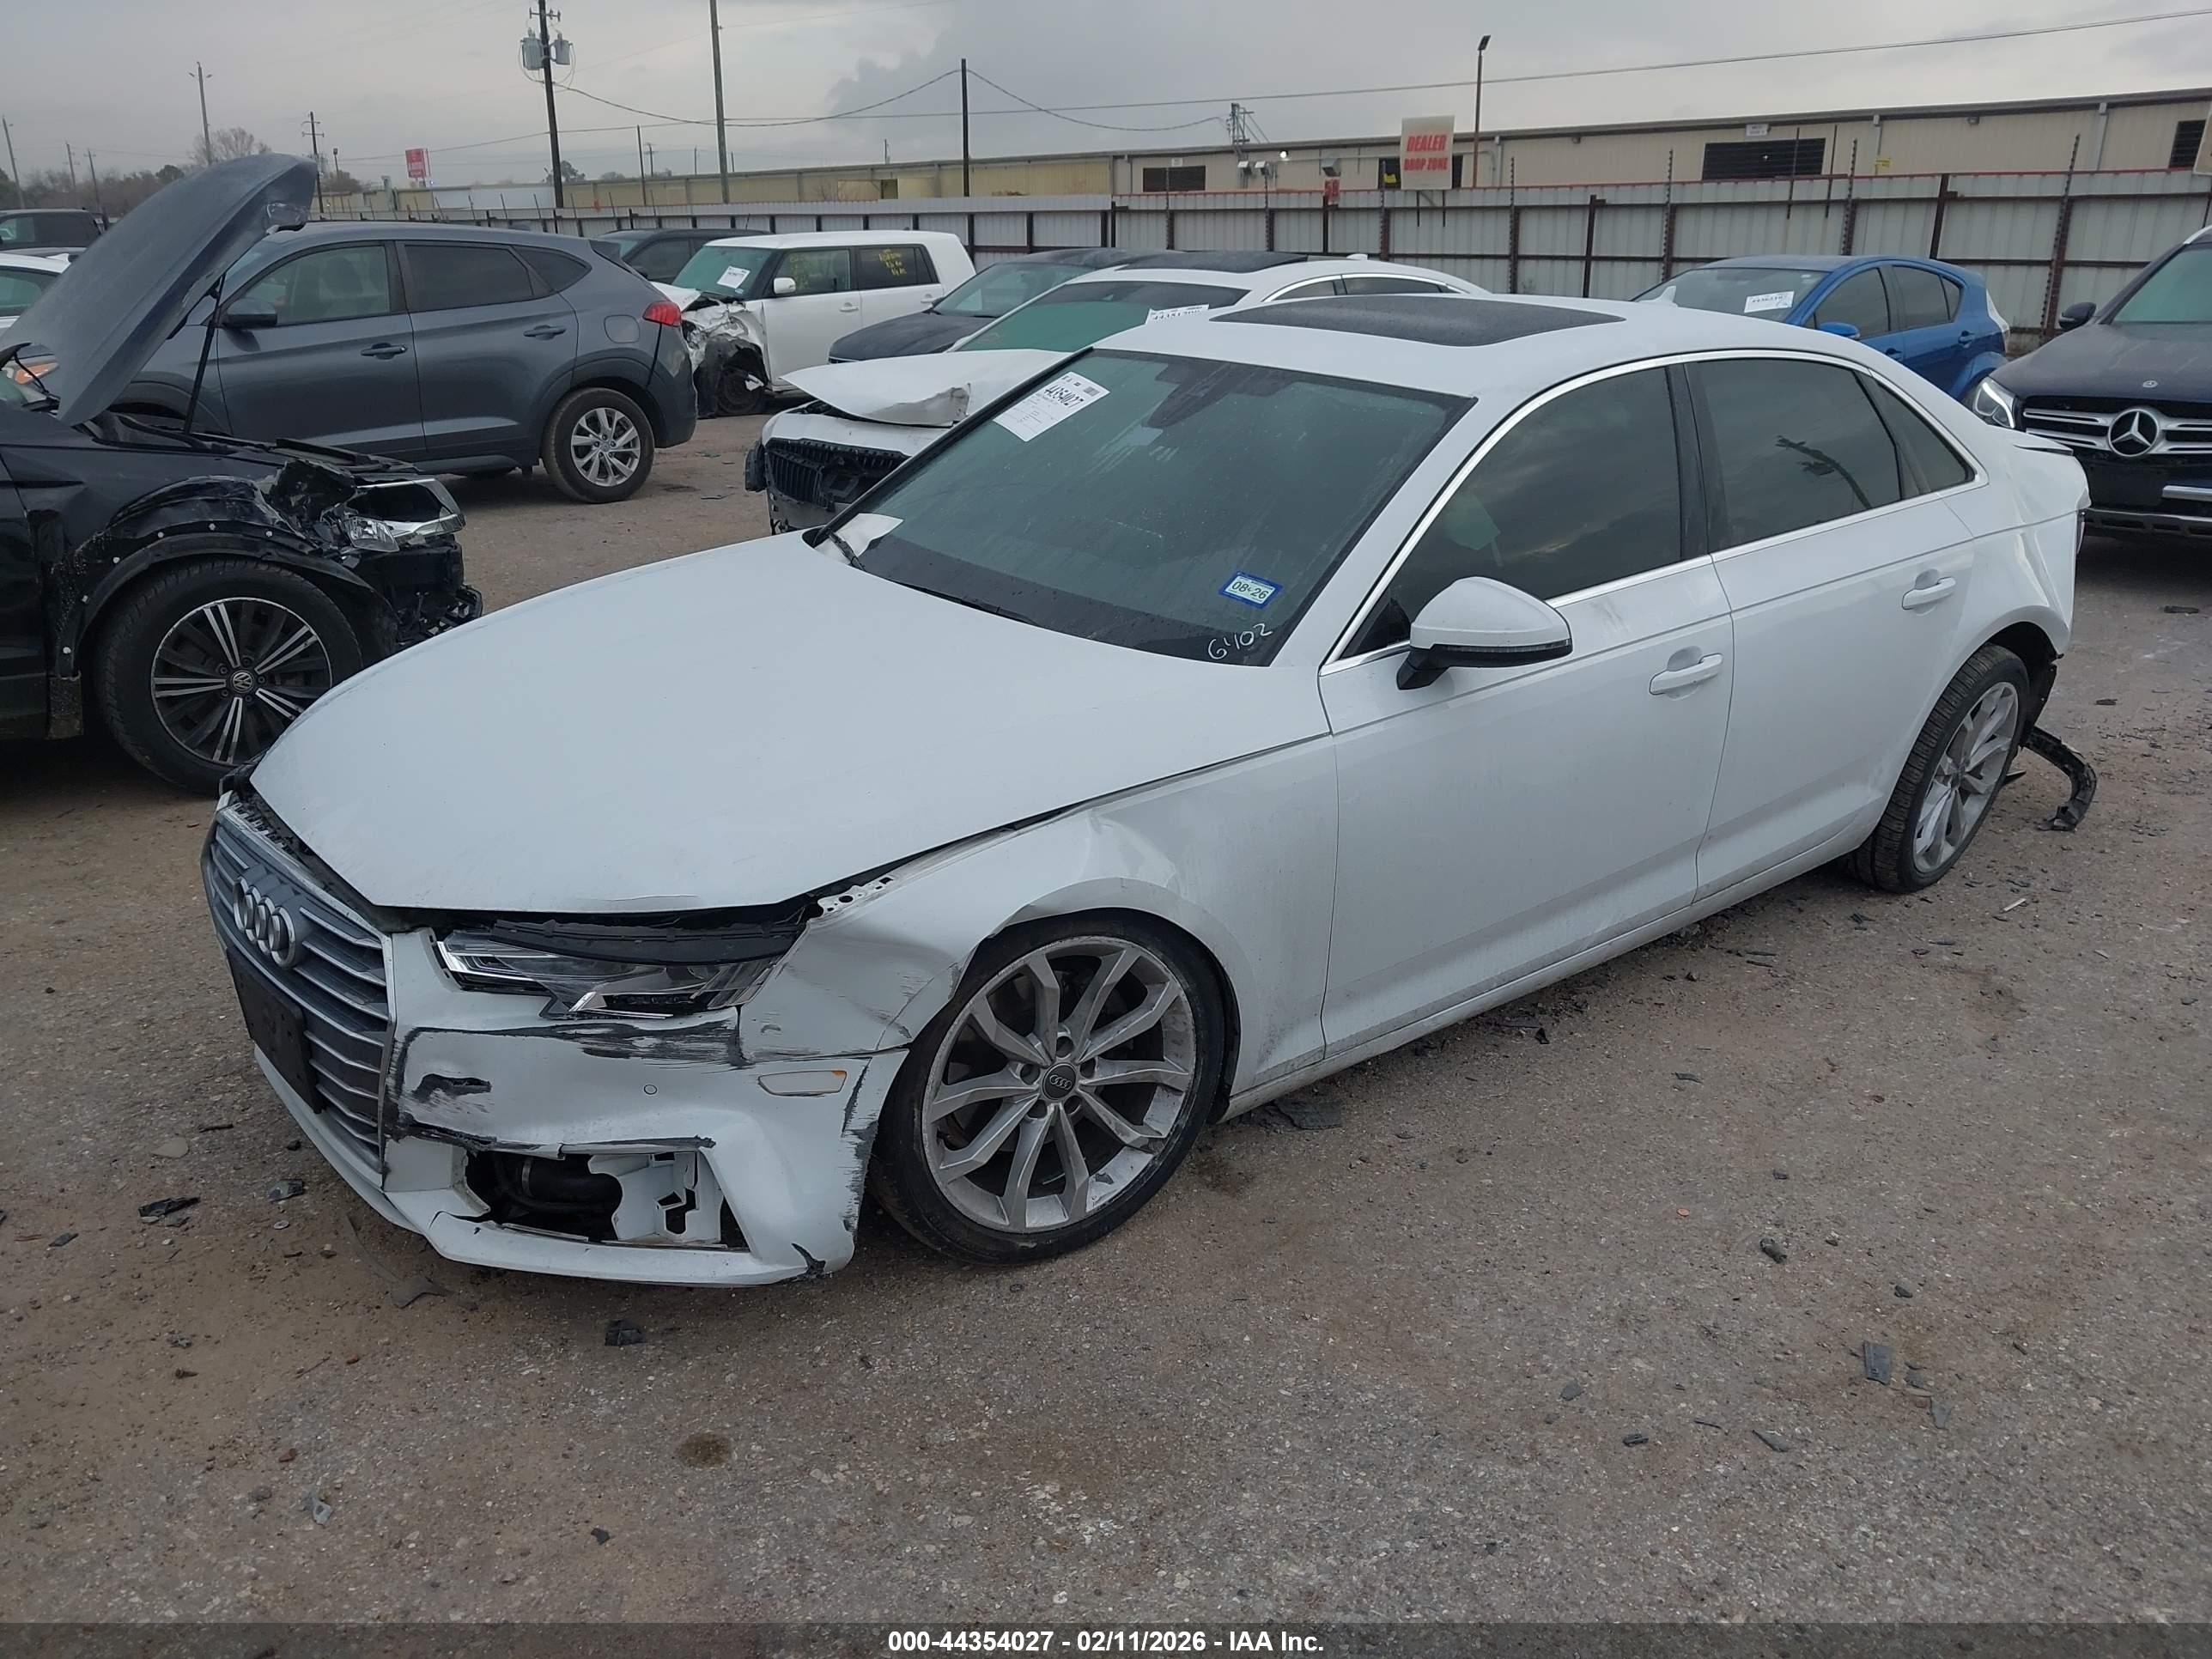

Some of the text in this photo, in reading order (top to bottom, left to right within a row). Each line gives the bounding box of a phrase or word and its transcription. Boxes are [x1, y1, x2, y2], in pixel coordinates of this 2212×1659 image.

[1406, 134, 1448, 152] DEALER
[1403, 157, 1449, 172] DROP ZONE
[1043, 384, 1085, 409] 44354027
